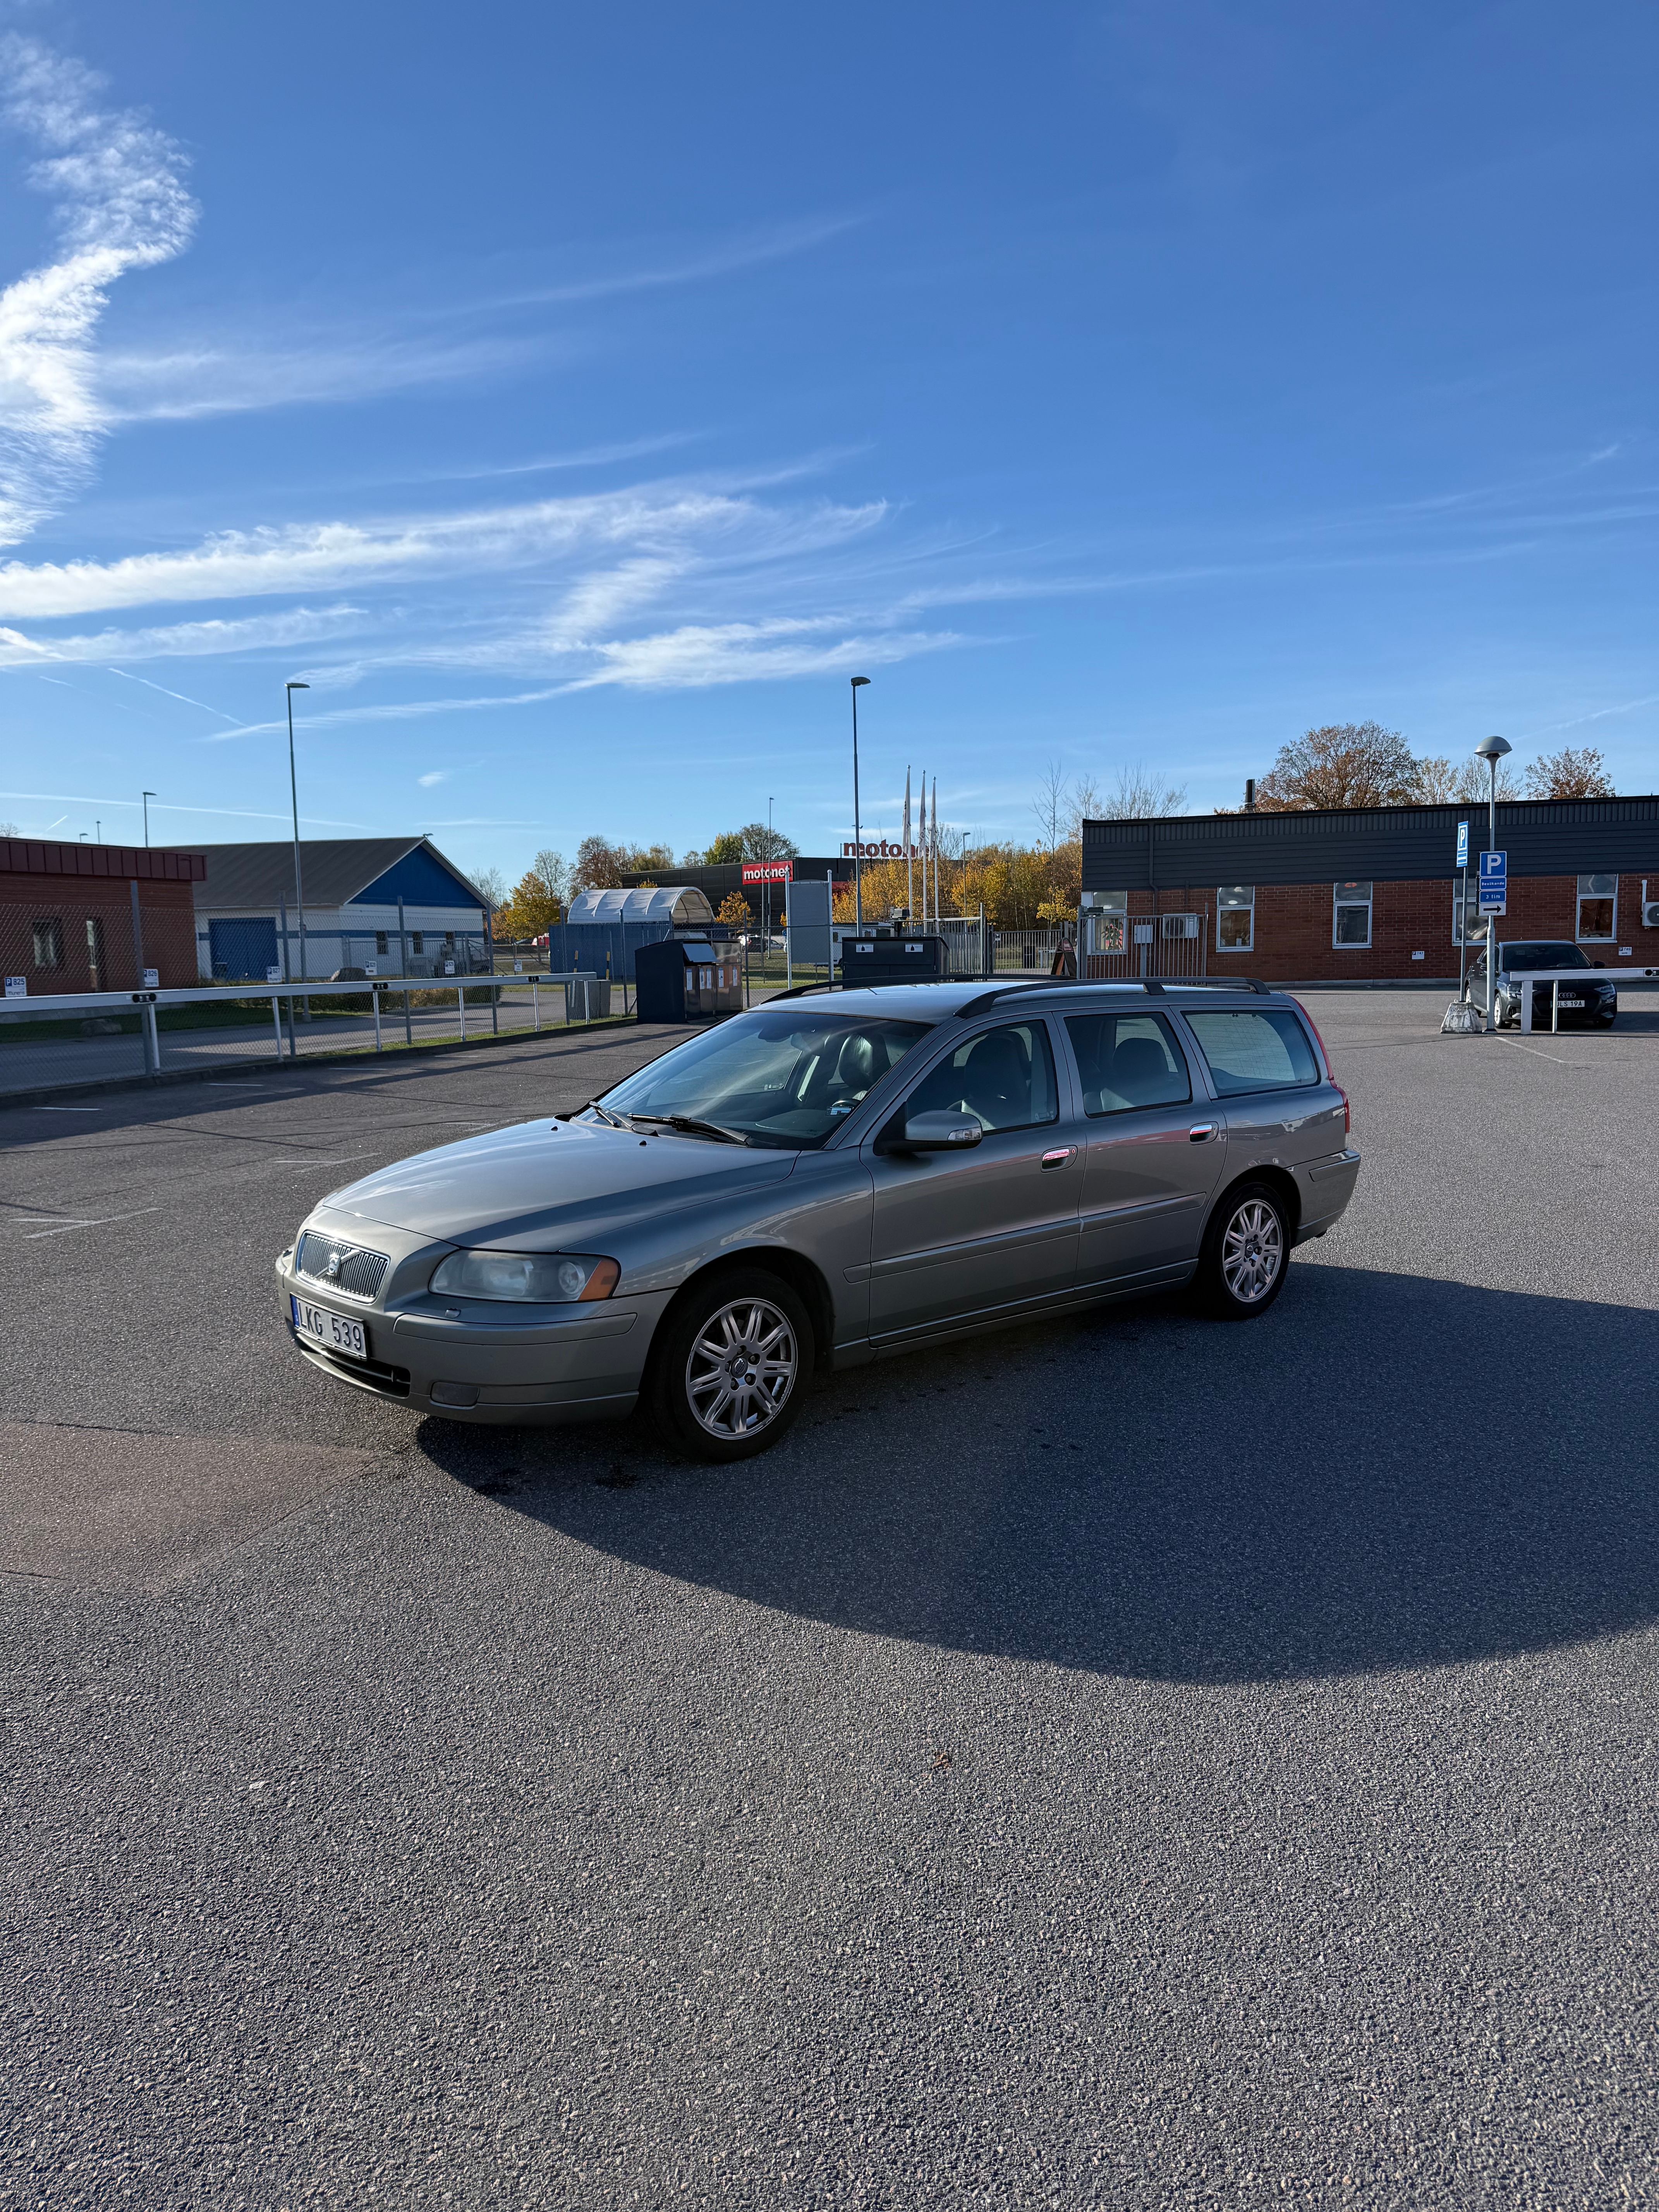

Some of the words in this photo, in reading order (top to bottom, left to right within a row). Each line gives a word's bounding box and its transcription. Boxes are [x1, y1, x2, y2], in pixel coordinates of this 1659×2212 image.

[1460, 829, 1465, 847] P
[844, 839, 935, 858] moto
[744, 865, 790, 880] motonet
[1487, 854, 1501, 874] P
[298, 1301, 323, 1336] LKG
[331, 1317, 362, 1351] 539
